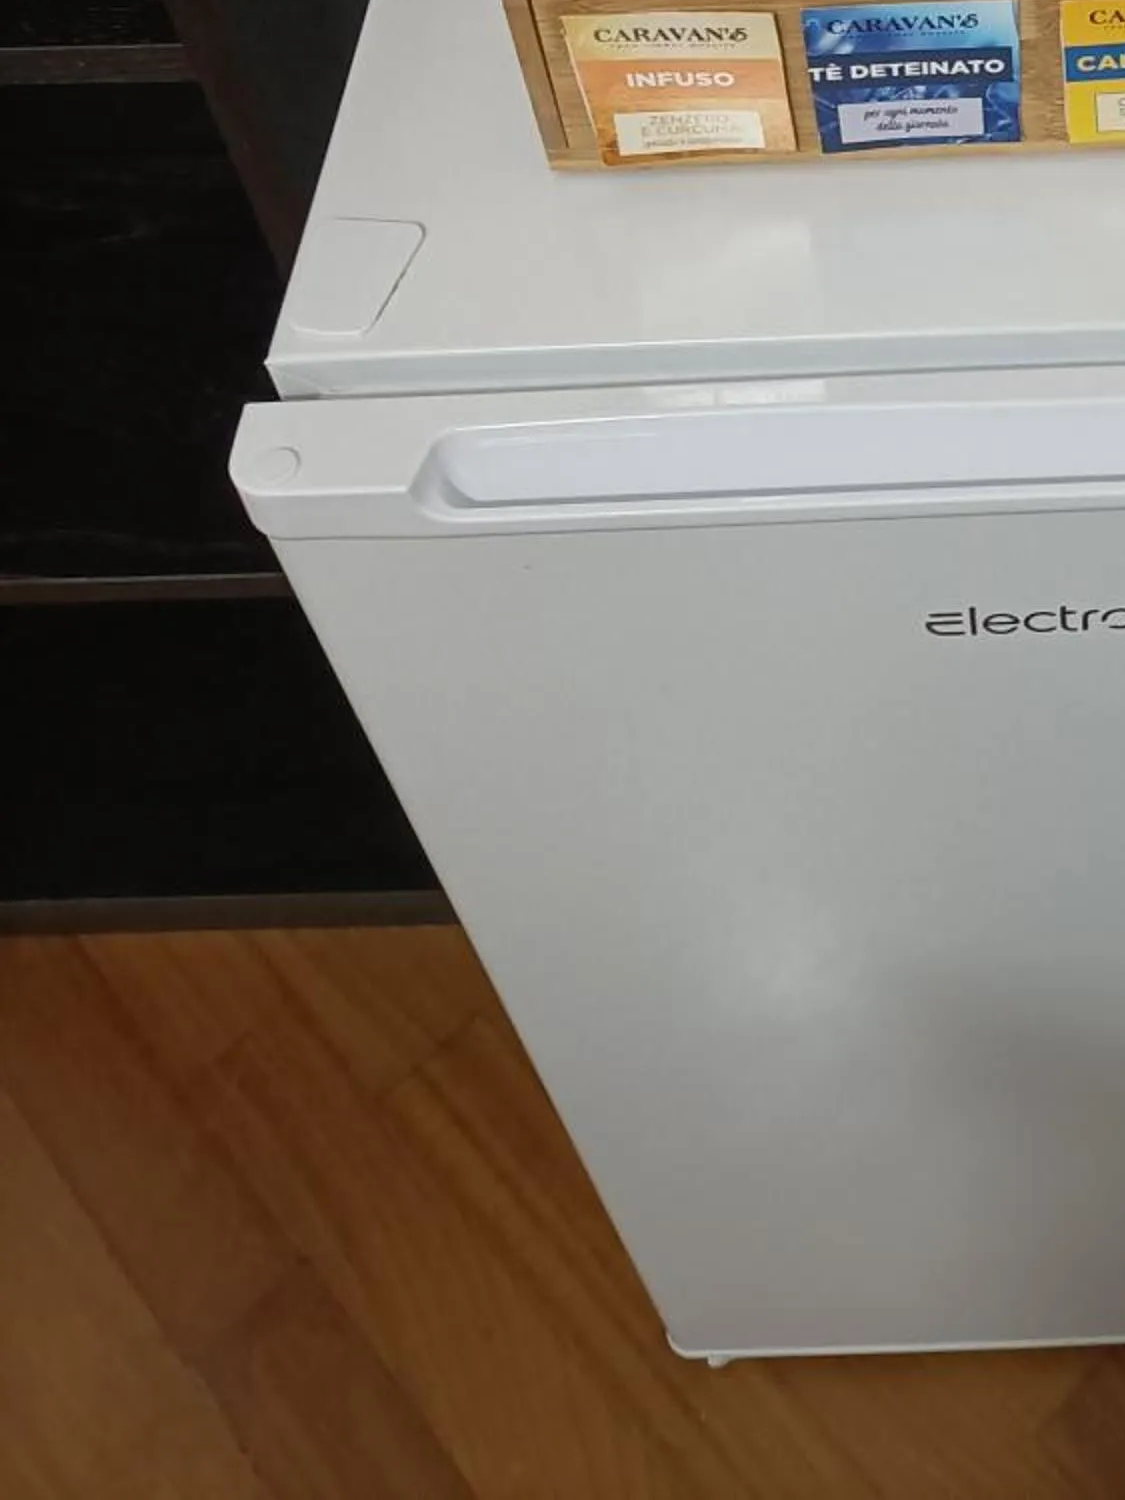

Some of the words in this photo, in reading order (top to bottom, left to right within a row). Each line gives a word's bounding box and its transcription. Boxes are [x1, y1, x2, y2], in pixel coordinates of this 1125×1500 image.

[827, 13, 979, 35] CARAVAN'S
[594, 27, 748, 43] CARAVAN'S
[626, 72, 735, 88] INFUSO
[807, 63, 843, 82] TÈ
[850, 59, 1005, 80] DETEINATO
